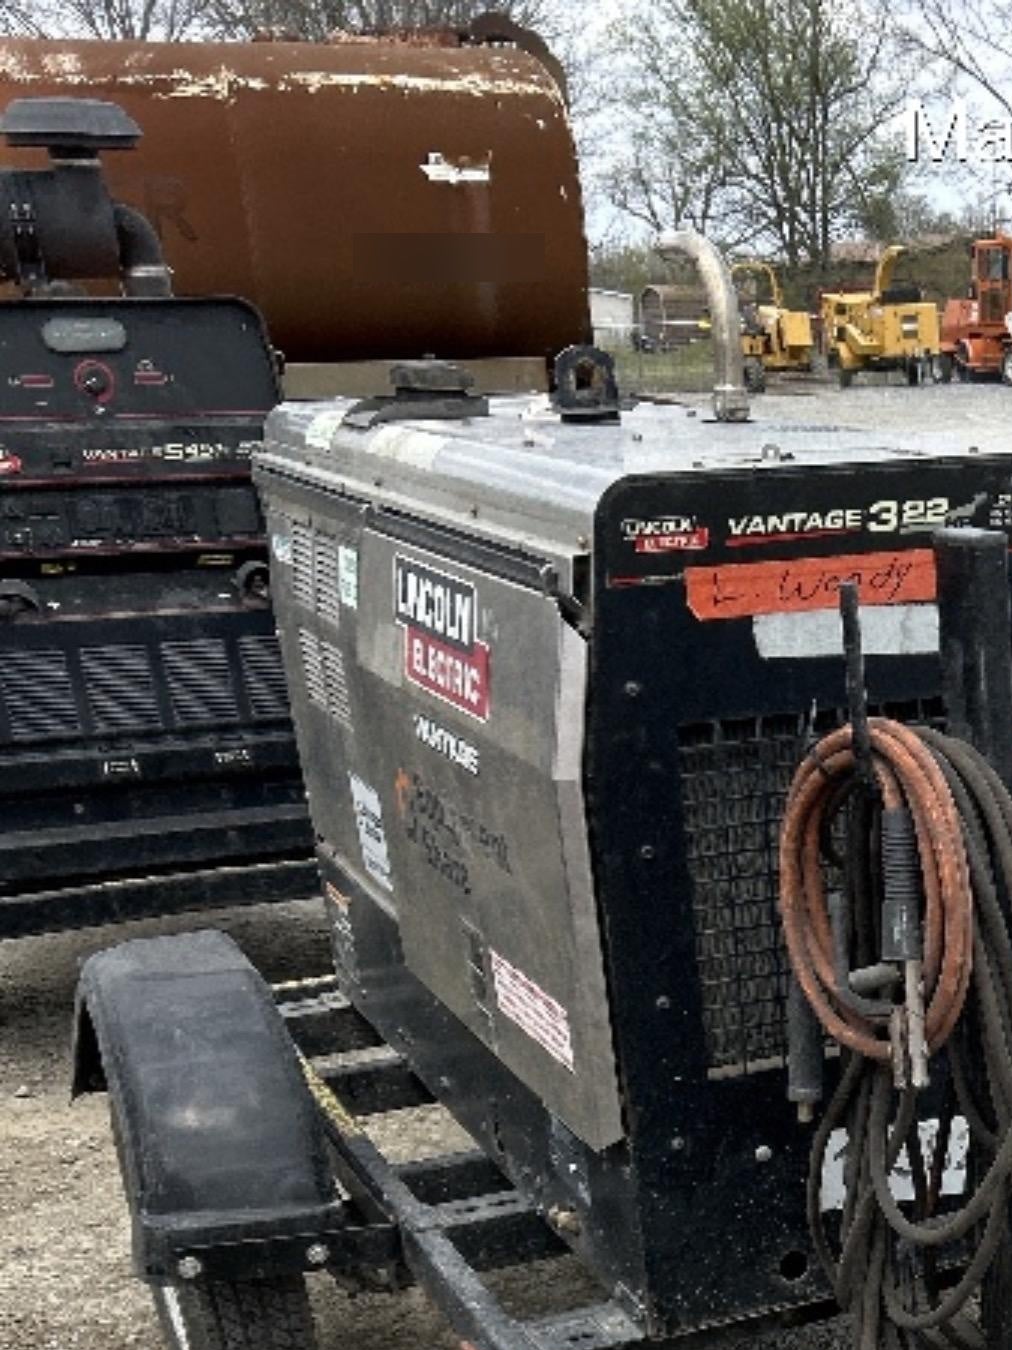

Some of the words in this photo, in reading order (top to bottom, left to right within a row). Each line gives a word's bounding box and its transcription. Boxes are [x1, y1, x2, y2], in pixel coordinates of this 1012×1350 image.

[728, 508, 863, 536] VANTAGE
[866, 496, 950, 533] 322
[397, 563, 473, 647] LINCOLN
[412, 637, 483, 707] ELECTRIC
